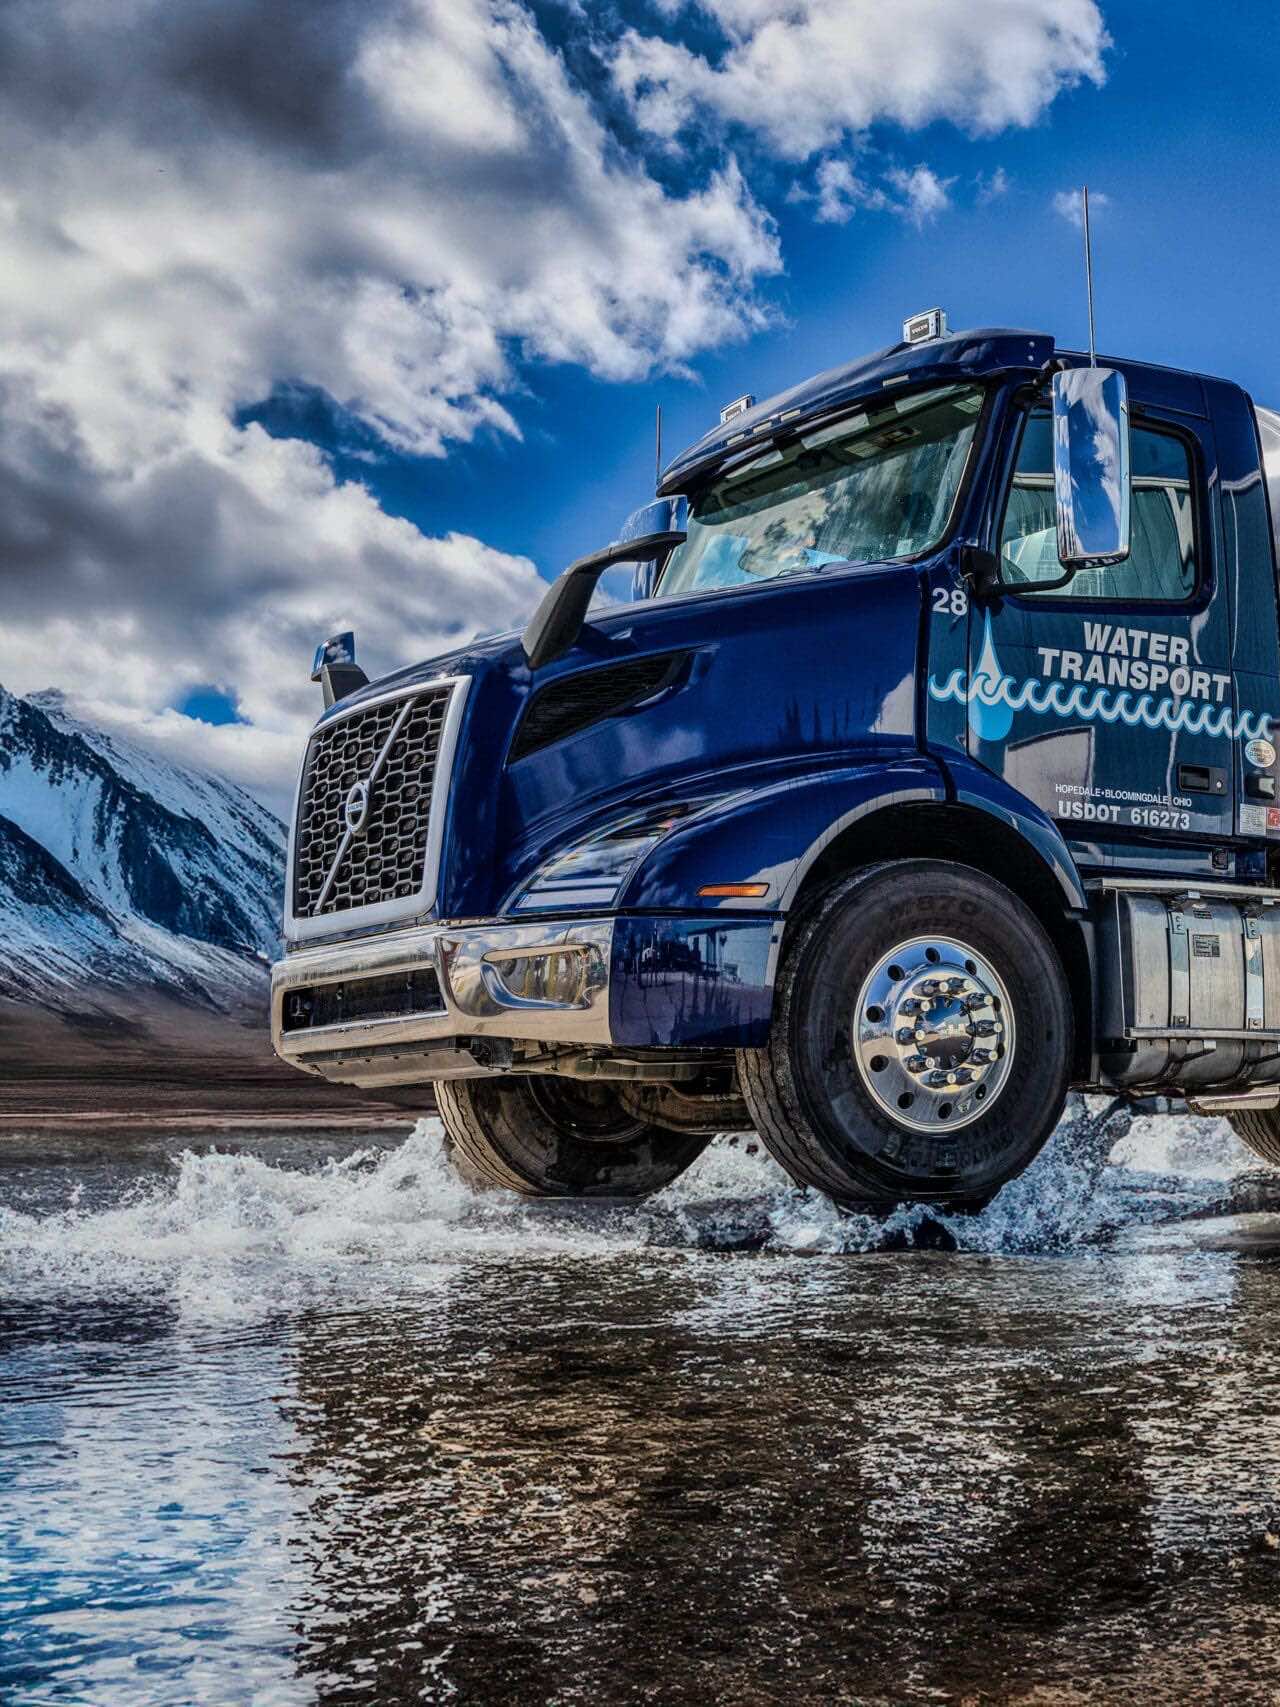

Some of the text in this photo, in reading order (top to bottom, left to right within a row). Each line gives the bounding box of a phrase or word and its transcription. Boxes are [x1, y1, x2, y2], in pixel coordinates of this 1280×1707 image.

[932, 587, 968, 616] 28
[1083, 621, 1190, 665] WATER
[1038, 647, 1231, 702] TRANSPORT
[1057, 800, 1190, 830] USDOT 616273
[1172, 796, 1192, 807] OHIO
